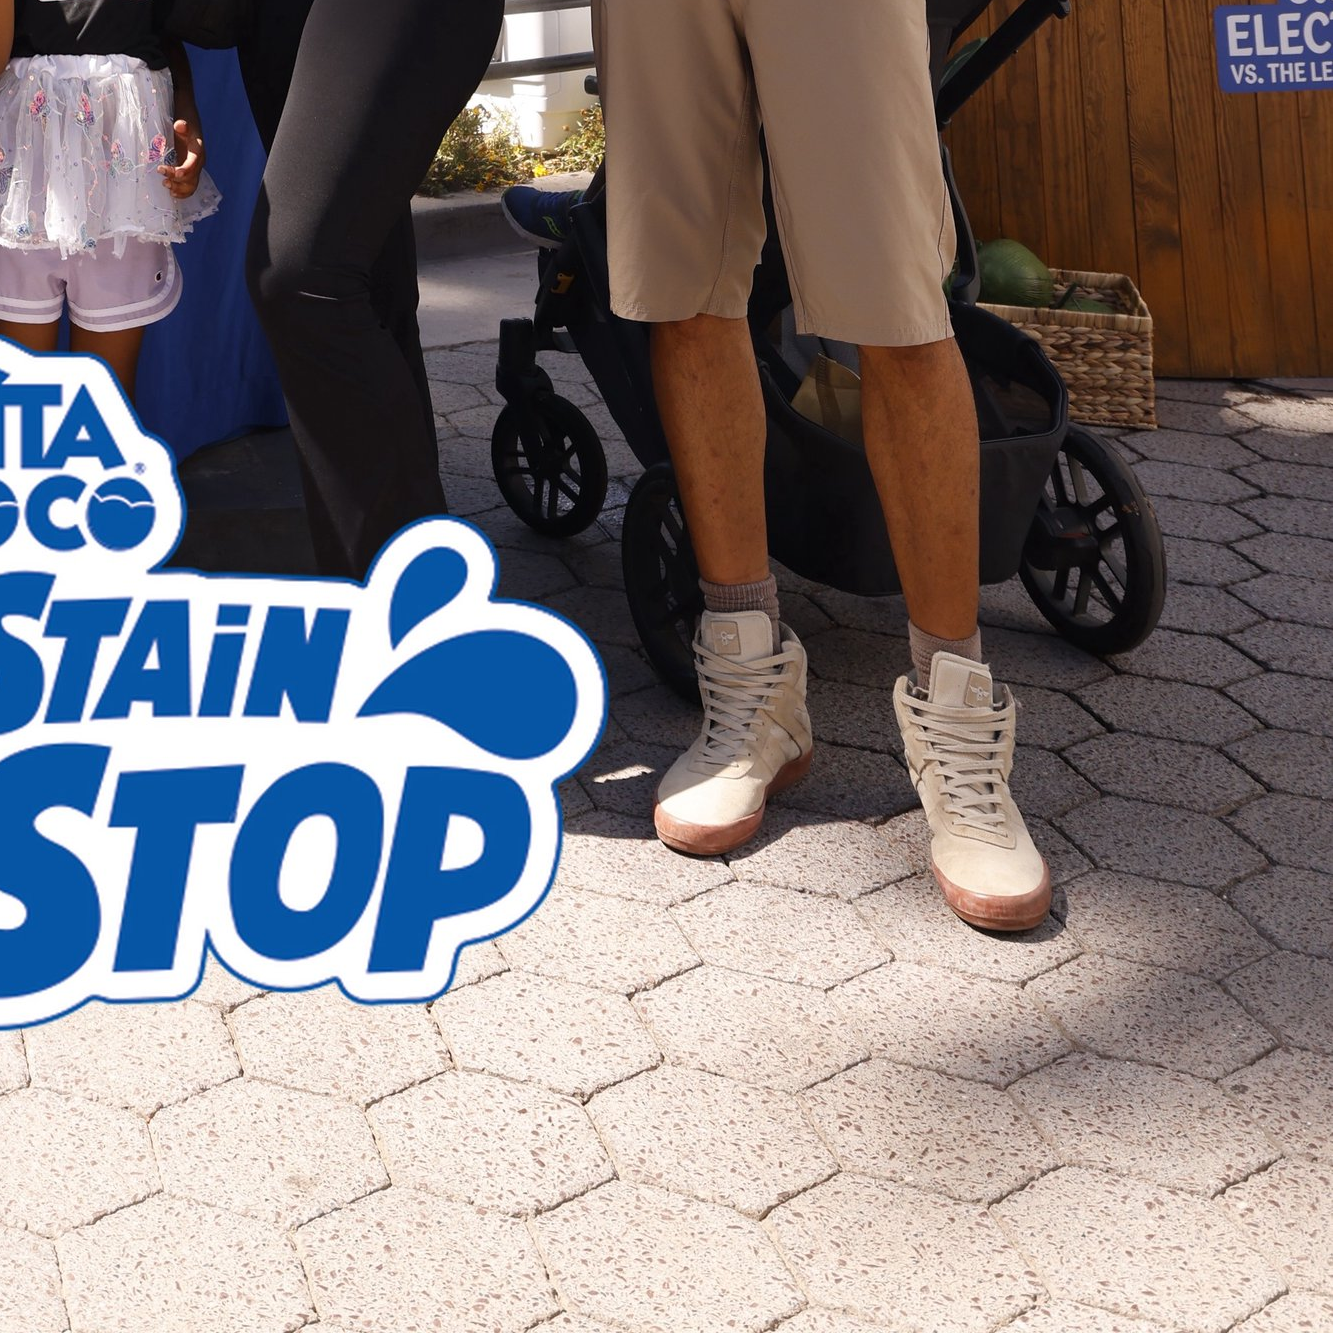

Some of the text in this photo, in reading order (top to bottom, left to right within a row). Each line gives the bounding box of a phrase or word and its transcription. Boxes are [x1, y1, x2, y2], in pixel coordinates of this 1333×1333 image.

[1226, 11, 1333, 57] ELEC
[1230, 64, 1264, 84] VS.
[1267, 62, 1307, 83] THE
